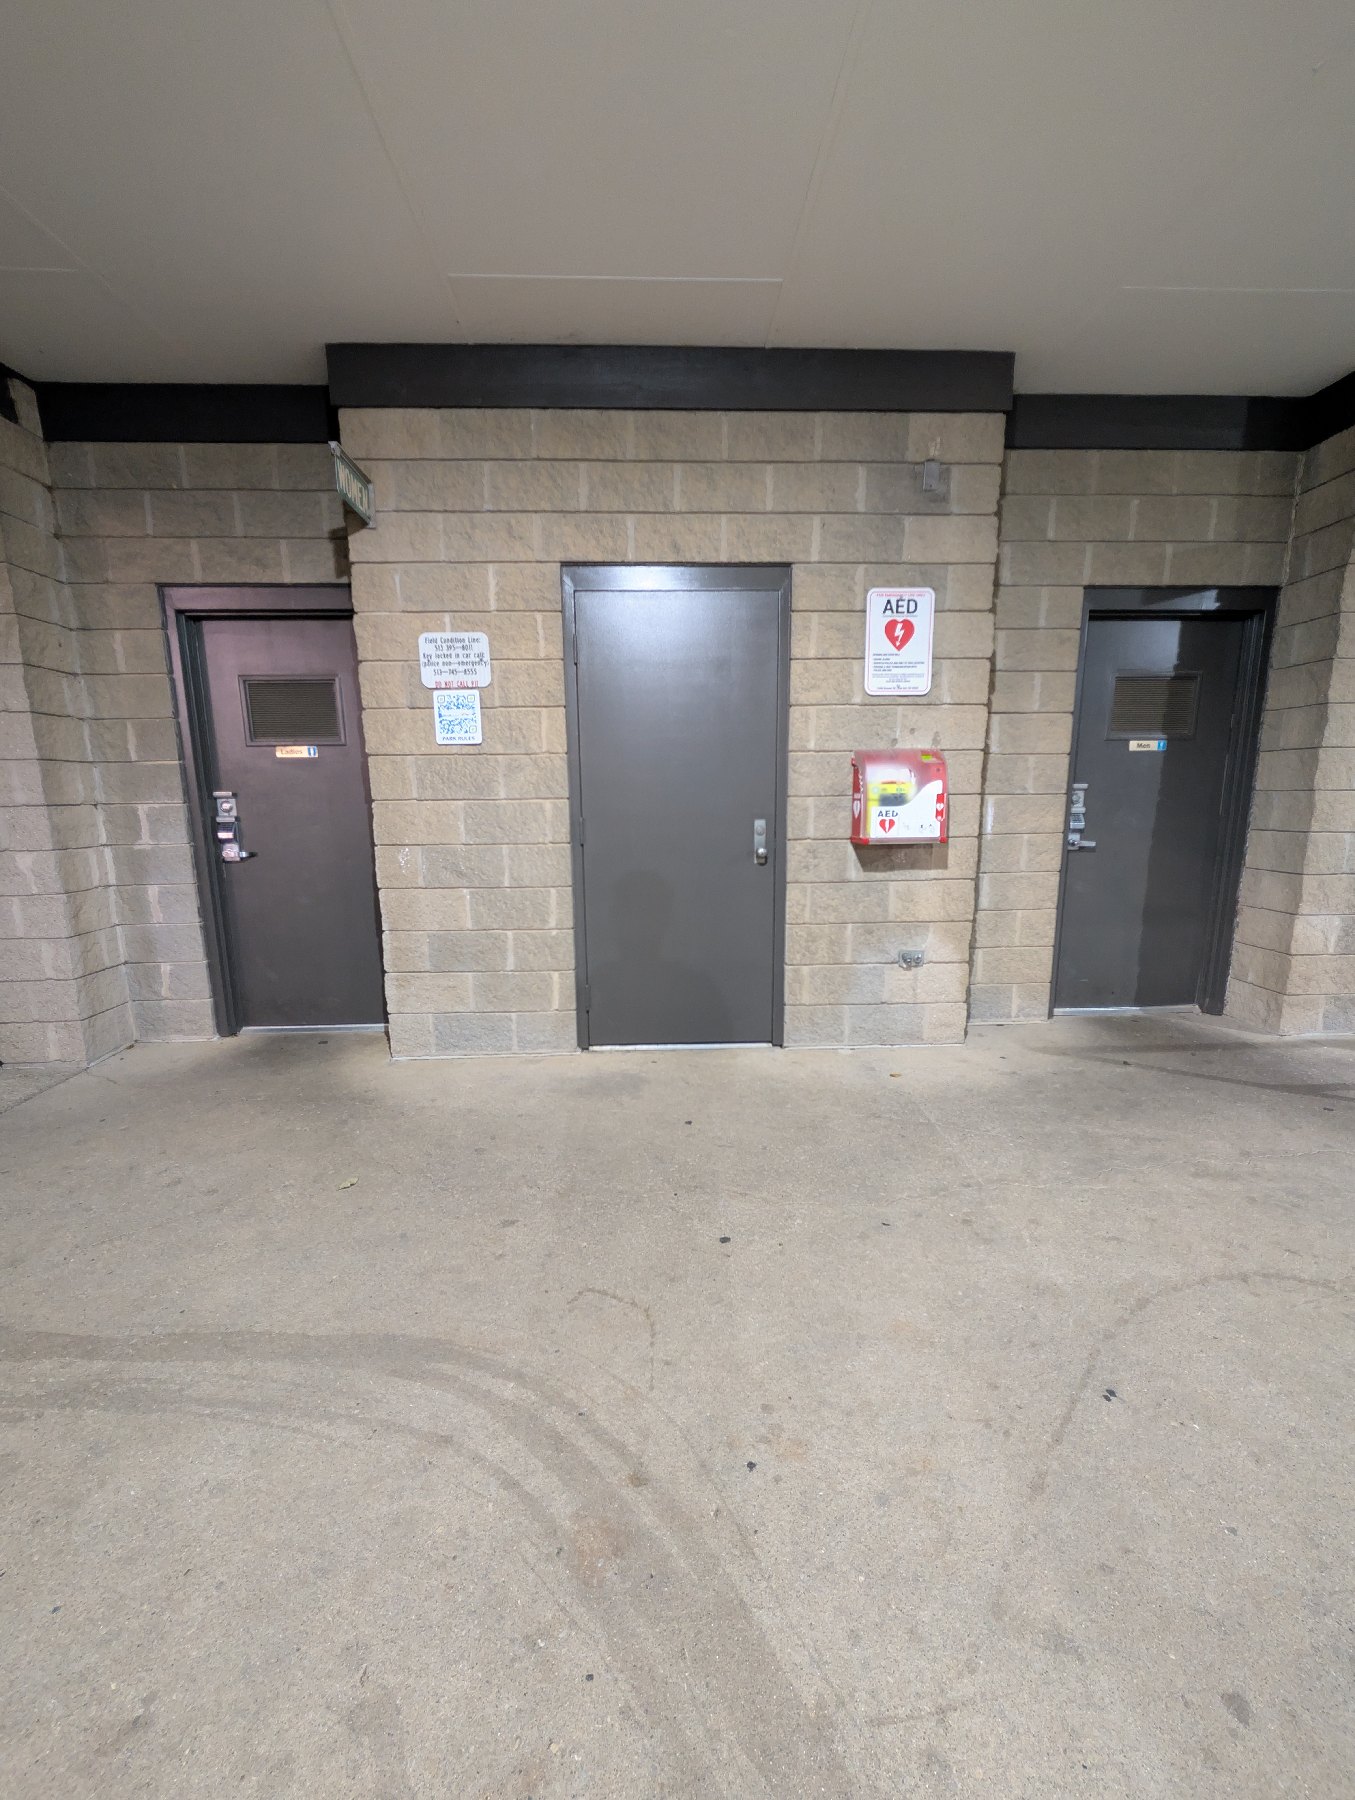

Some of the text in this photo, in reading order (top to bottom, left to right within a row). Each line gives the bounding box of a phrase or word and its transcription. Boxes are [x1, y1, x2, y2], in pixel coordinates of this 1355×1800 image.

[338, 459, 368, 513] WOMEN
[882, 598, 918, 614] AED
[422, 652, 433, 660] Key
[878, 810, 899, 818] AED
